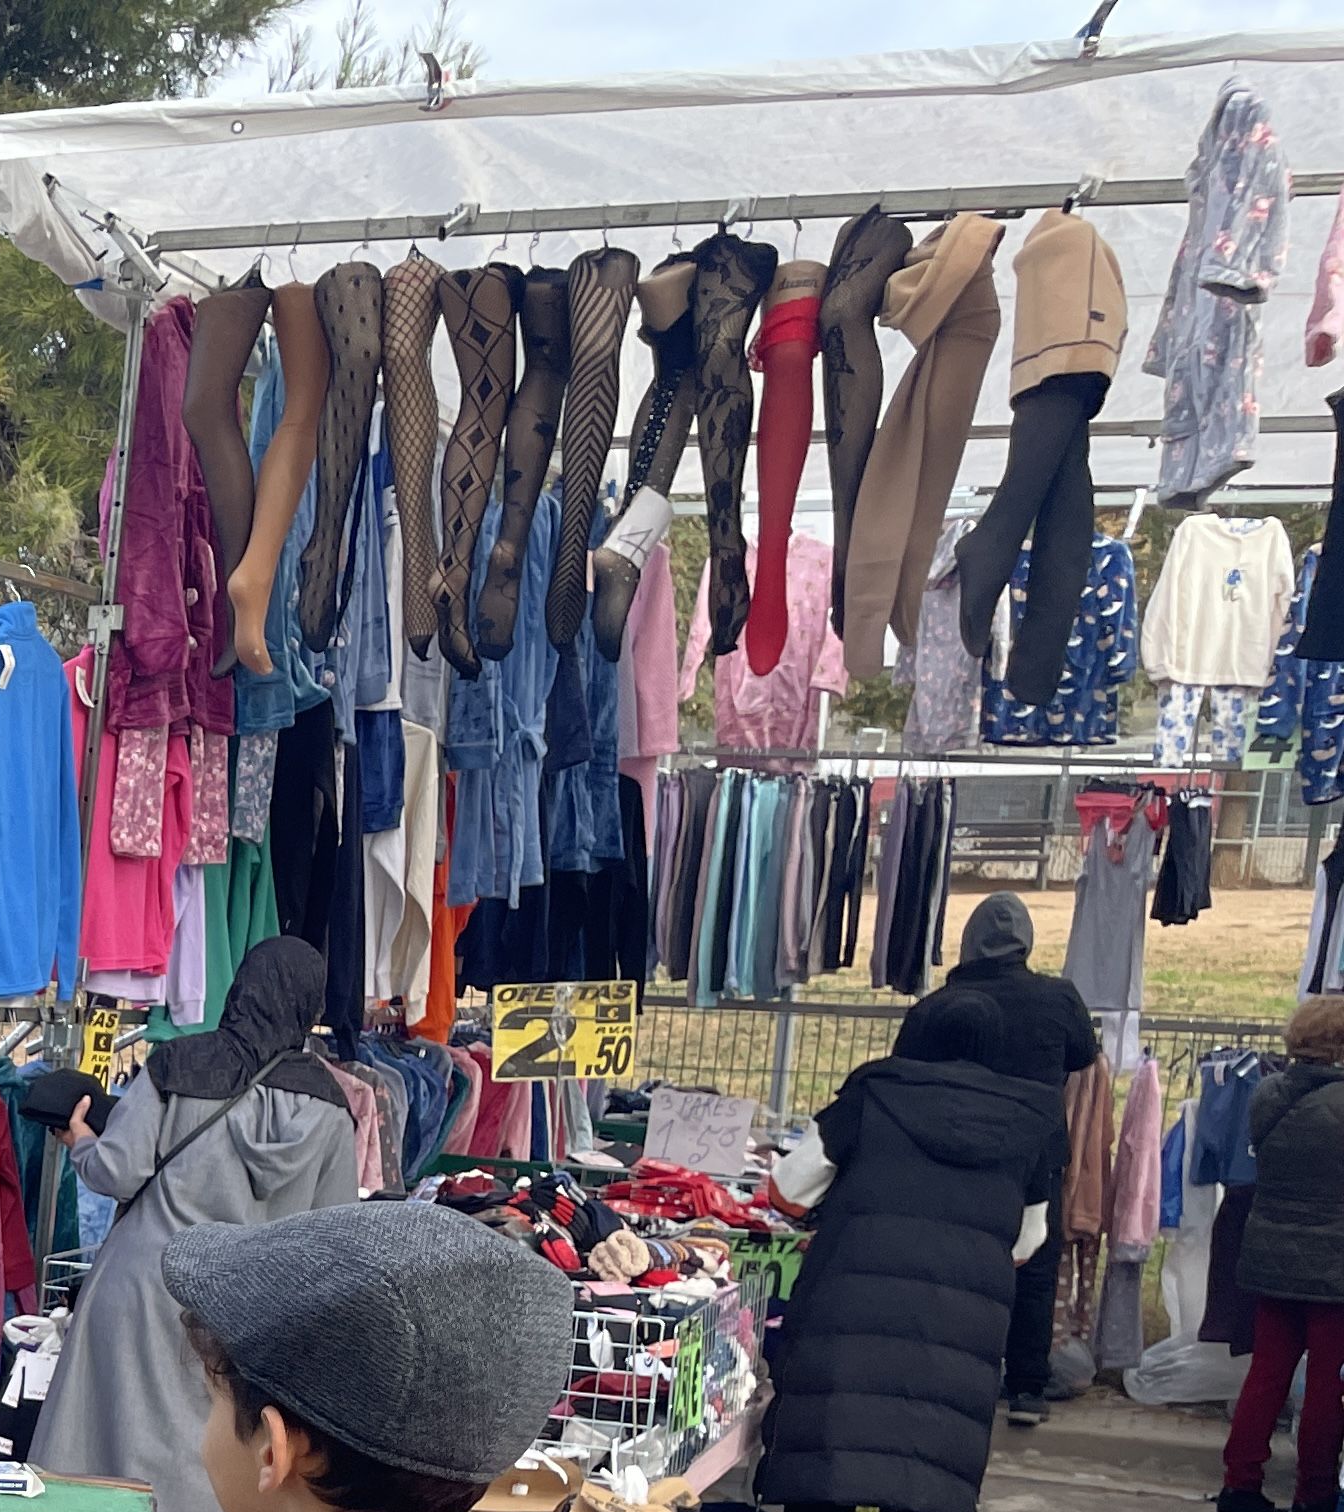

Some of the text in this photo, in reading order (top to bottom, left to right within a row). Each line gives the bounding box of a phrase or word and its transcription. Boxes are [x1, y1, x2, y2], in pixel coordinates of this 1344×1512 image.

[497, 984, 632, 1002] OFETAS
[496, 1006, 577, 1077] 2
[660, 1094, 672, 1110] 3
